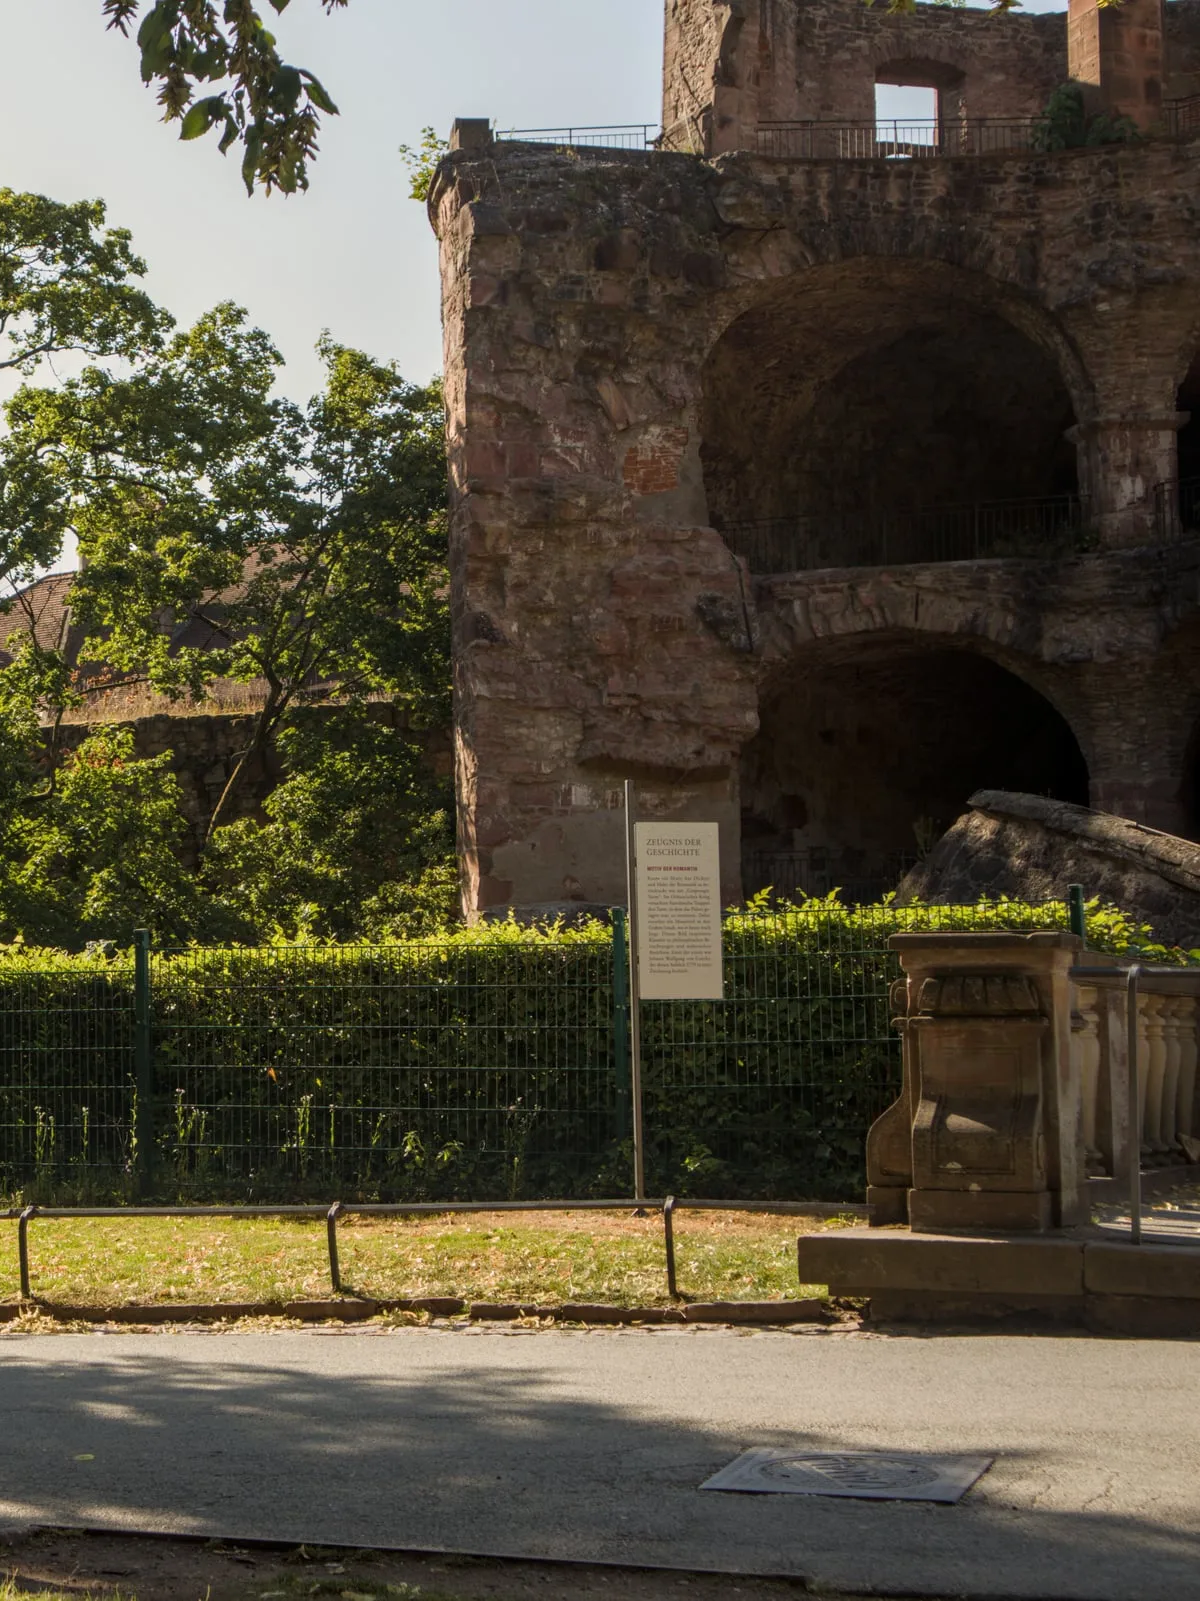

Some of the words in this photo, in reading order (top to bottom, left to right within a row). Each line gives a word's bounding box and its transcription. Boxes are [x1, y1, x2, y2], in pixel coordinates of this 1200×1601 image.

[646, 838, 683, 846] ZEUGNIS
[684, 838, 702, 846] DER
[646, 848, 700, 856] GESCHICHTE
